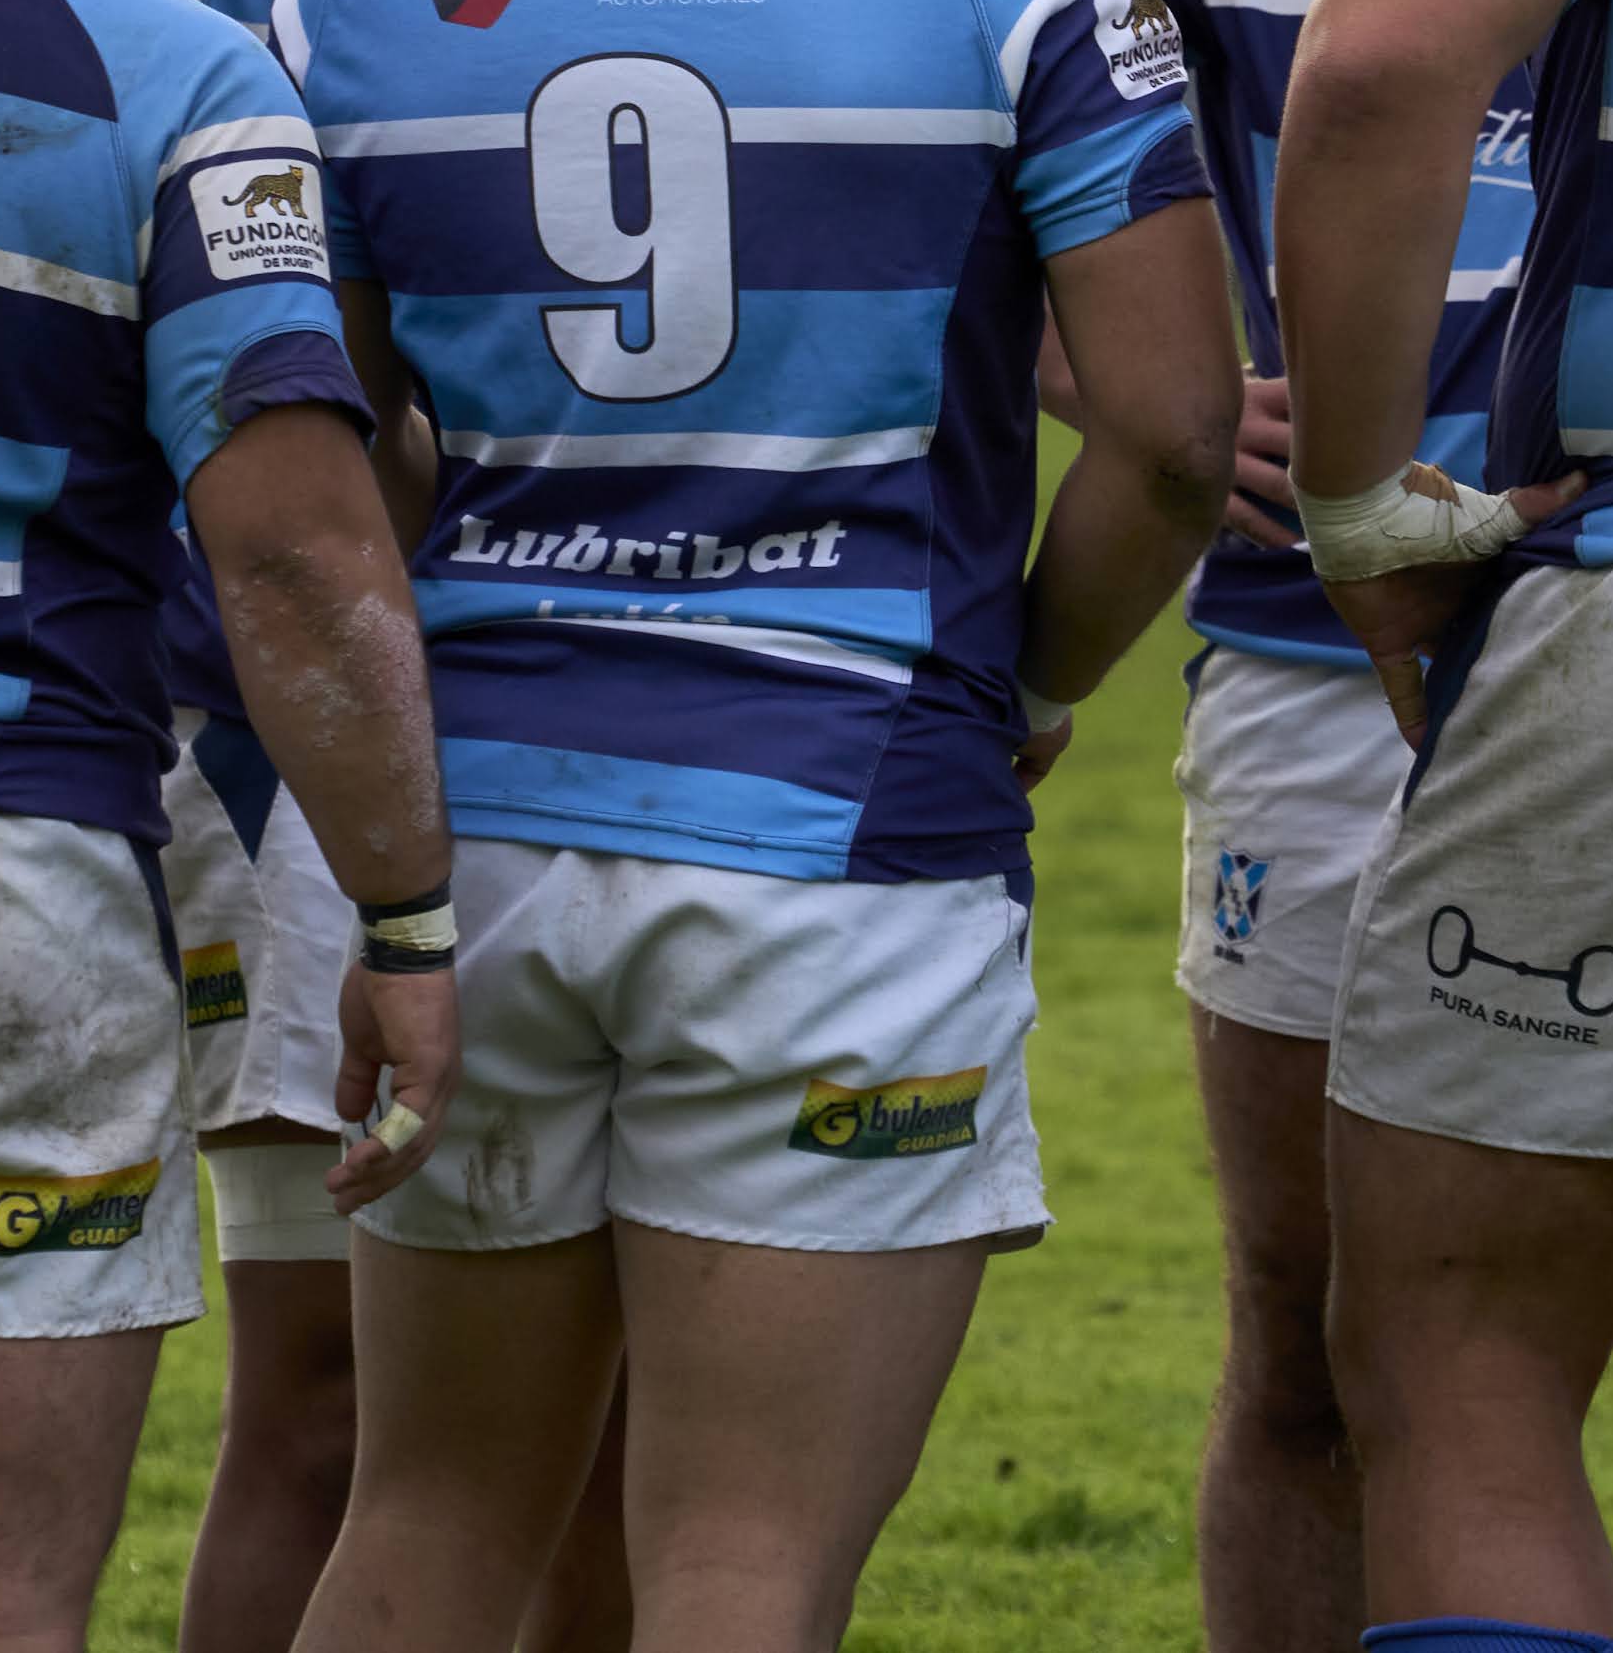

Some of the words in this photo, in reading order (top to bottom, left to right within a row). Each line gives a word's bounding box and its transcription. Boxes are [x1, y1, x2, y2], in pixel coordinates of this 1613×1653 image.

[1109, 31, 1183, 74] FUNDACIÓ
[228, 243, 276, 262] UNIÓN
[524, 51, 740, 405] 9
[262, 258, 280, 269] DE
[449, 513, 848, 581] Lubribat
[1430, 985, 1488, 1023] PURA
[1492, 1009, 1600, 1046] SANGRE
